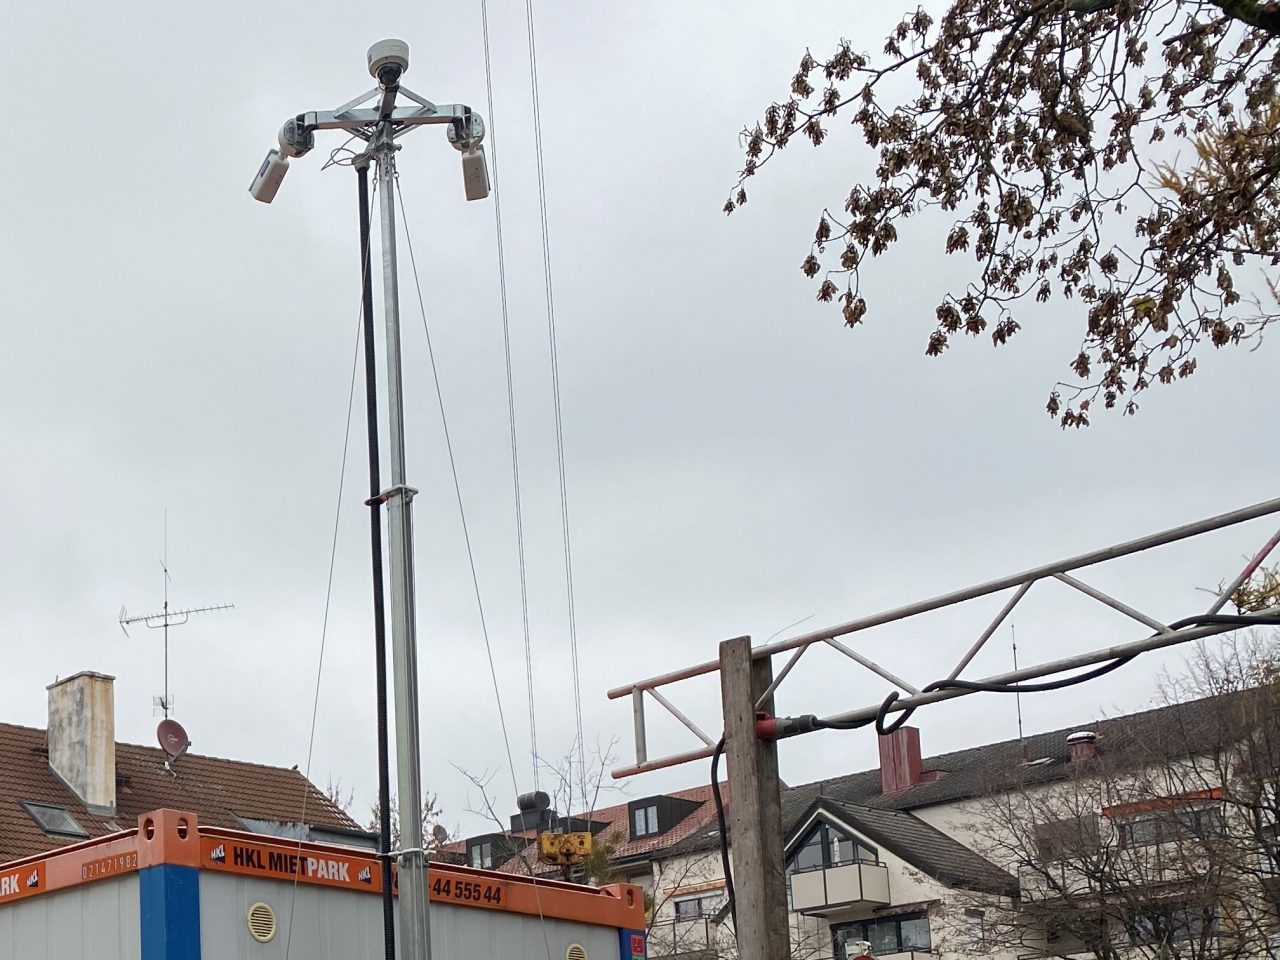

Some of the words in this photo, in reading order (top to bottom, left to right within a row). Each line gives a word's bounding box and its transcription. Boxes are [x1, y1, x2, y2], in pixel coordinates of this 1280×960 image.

[233, 846, 265, 869] HKL
[268, 852, 350, 882] MIETPARK
[454, 880, 481, 901] 555
[483, 885, 502, 905] 44
